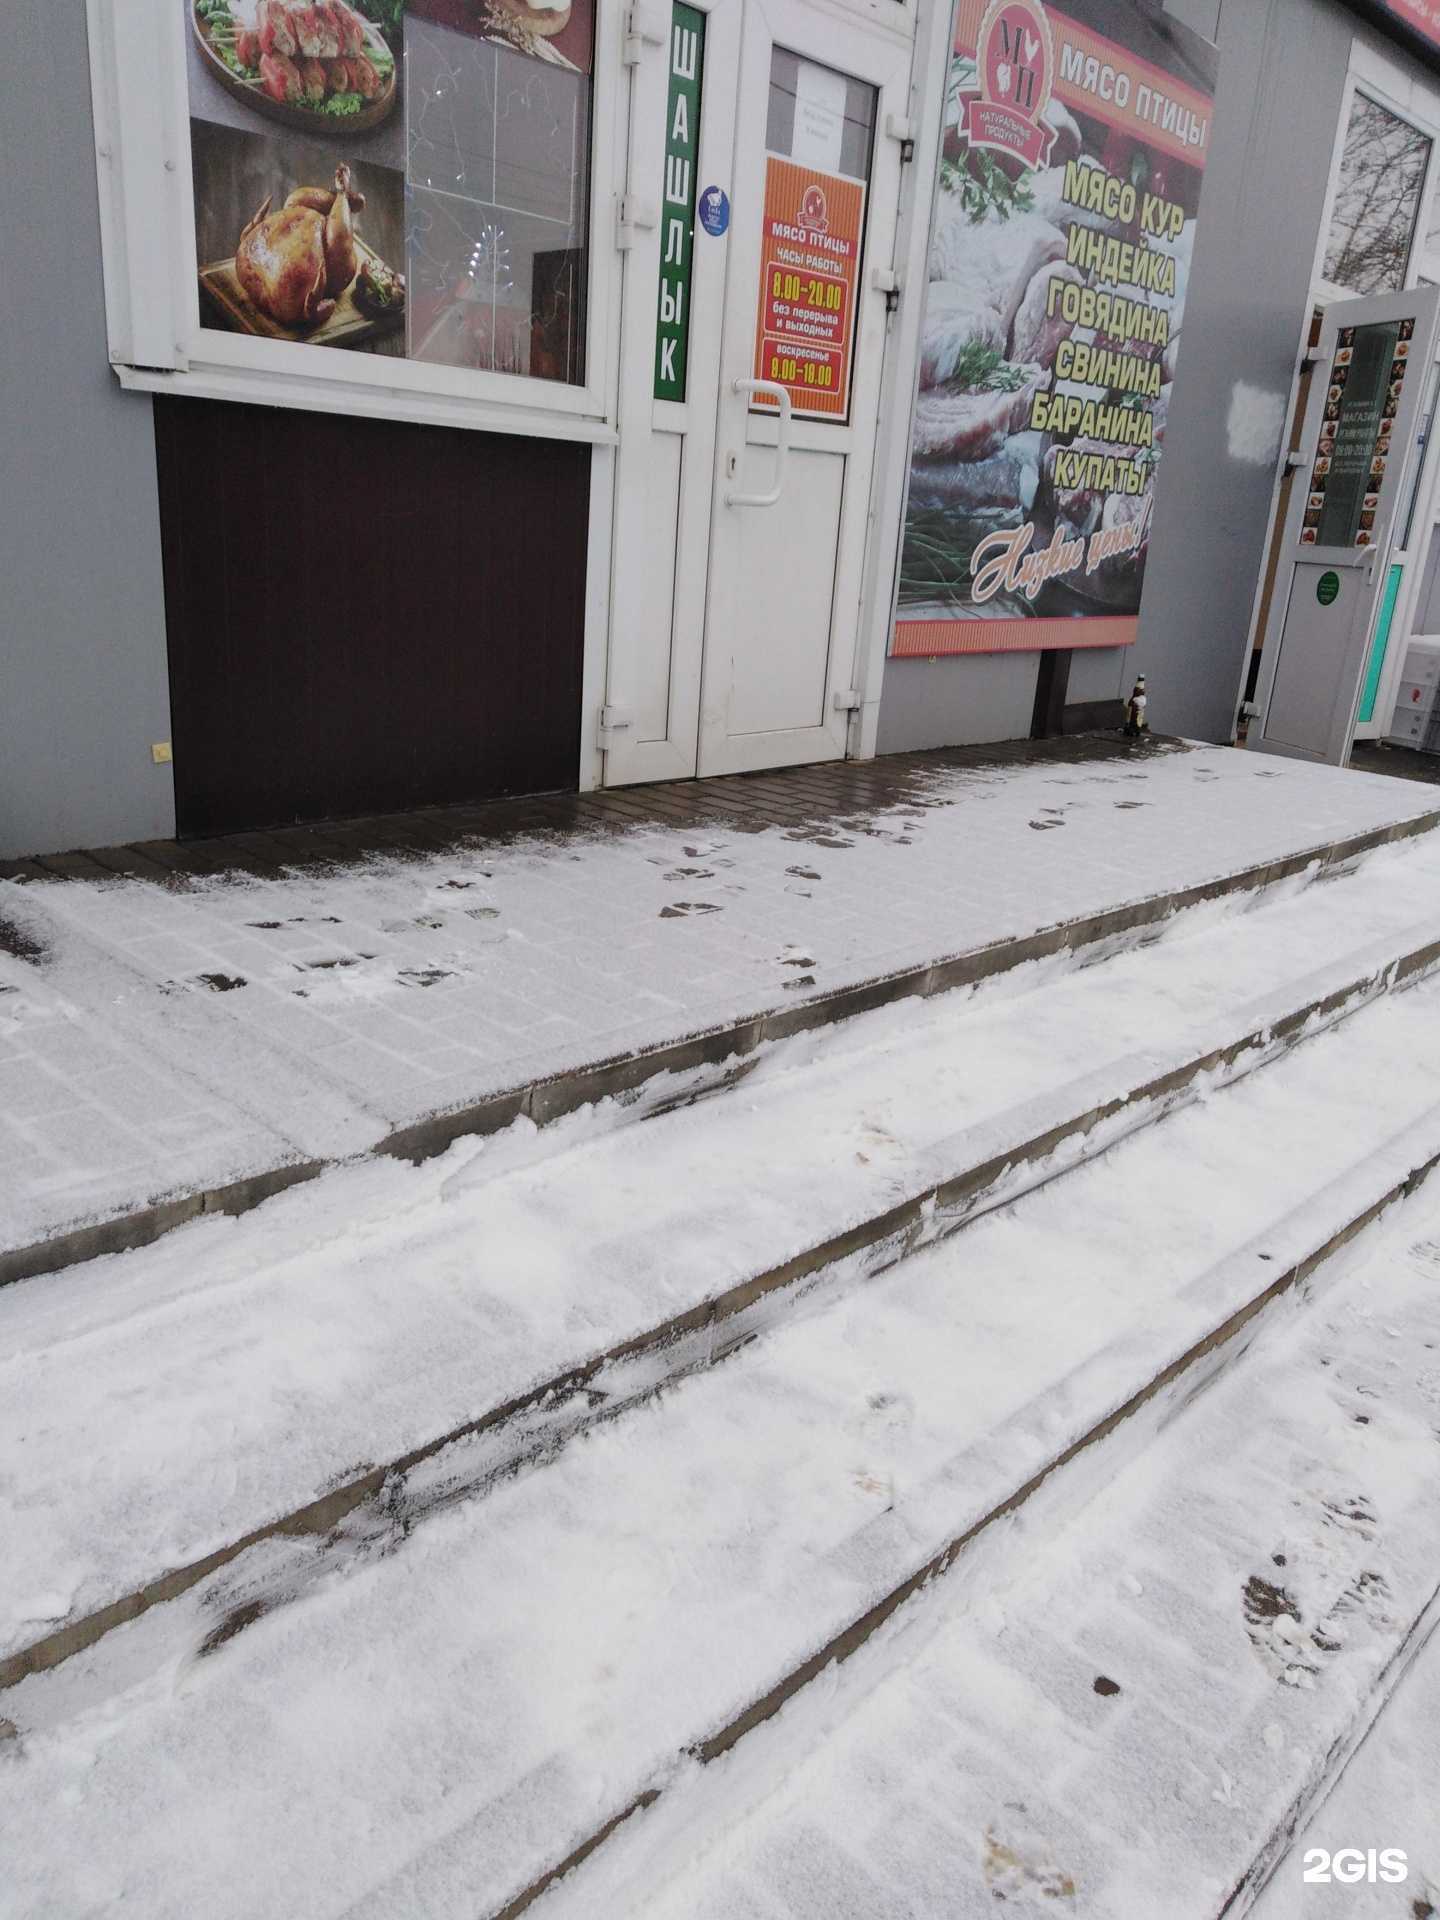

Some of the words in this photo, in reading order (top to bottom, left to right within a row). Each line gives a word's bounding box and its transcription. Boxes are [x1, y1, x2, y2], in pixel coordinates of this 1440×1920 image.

[1060, 43, 1131, 108] МЯСО
[1135, 83, 1207, 147] ПТИЦЫ
[984, 124, 1025, 147] ПРОДУКТЫ
[660, 25, 697, 382] ШАШЛЫК
[1062, 158, 1138, 225] МЯСО
[1139, 191, 1185, 243] КУР
[771, 222, 806, 244] МЯСО
[809, 232, 850, 256] ПТИЦЫ
[777, 247, 804, 264] ЧАСЫ
[806, 254, 843, 273] РАБОТЫ
[1066, 222, 1177, 298] ИНДЕЙКА
[772, 301, 790, 315] без
[792, 307, 839, 325] перерыва
[776, 318, 783, 328] и
[785, 319, 834, 337] выходных
[1046, 276, 1170, 348] ГОВЯДИНА
[776, 344, 830, 362] воскресенье
[1055, 339, 1162, 399] СВИНИНА
[1030, 390, 1154, 449] БАРАНИНА
[1053, 449, 1149, 497] КУПАТЫ
[970, 521, 1085, 603] Низкие
